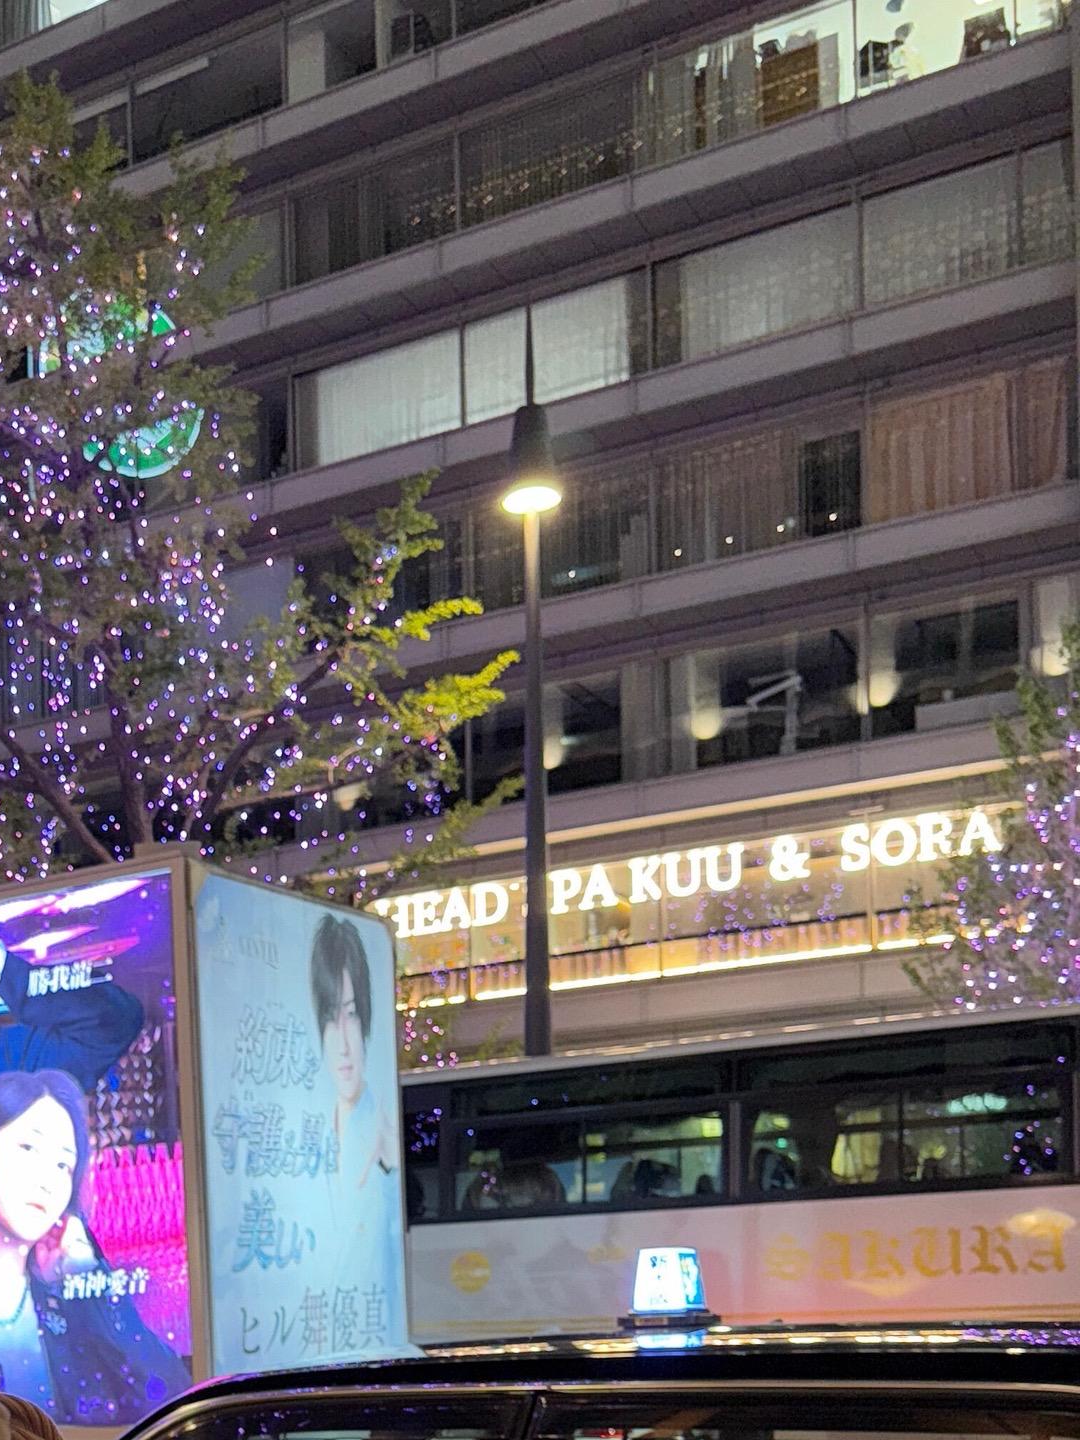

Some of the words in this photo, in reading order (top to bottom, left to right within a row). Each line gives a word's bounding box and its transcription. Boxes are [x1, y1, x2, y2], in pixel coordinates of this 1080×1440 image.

[374, 882, 508, 938] HEAD
[520, 864, 619, 915] PA
[628, 842, 744, 903] KUU
[770, 834, 810, 882] &
[840, 806, 1003, 872] SORA
[232, 1187, 316, 1273] 美しい
[764, 1222, 1067, 1281] SAKURA
